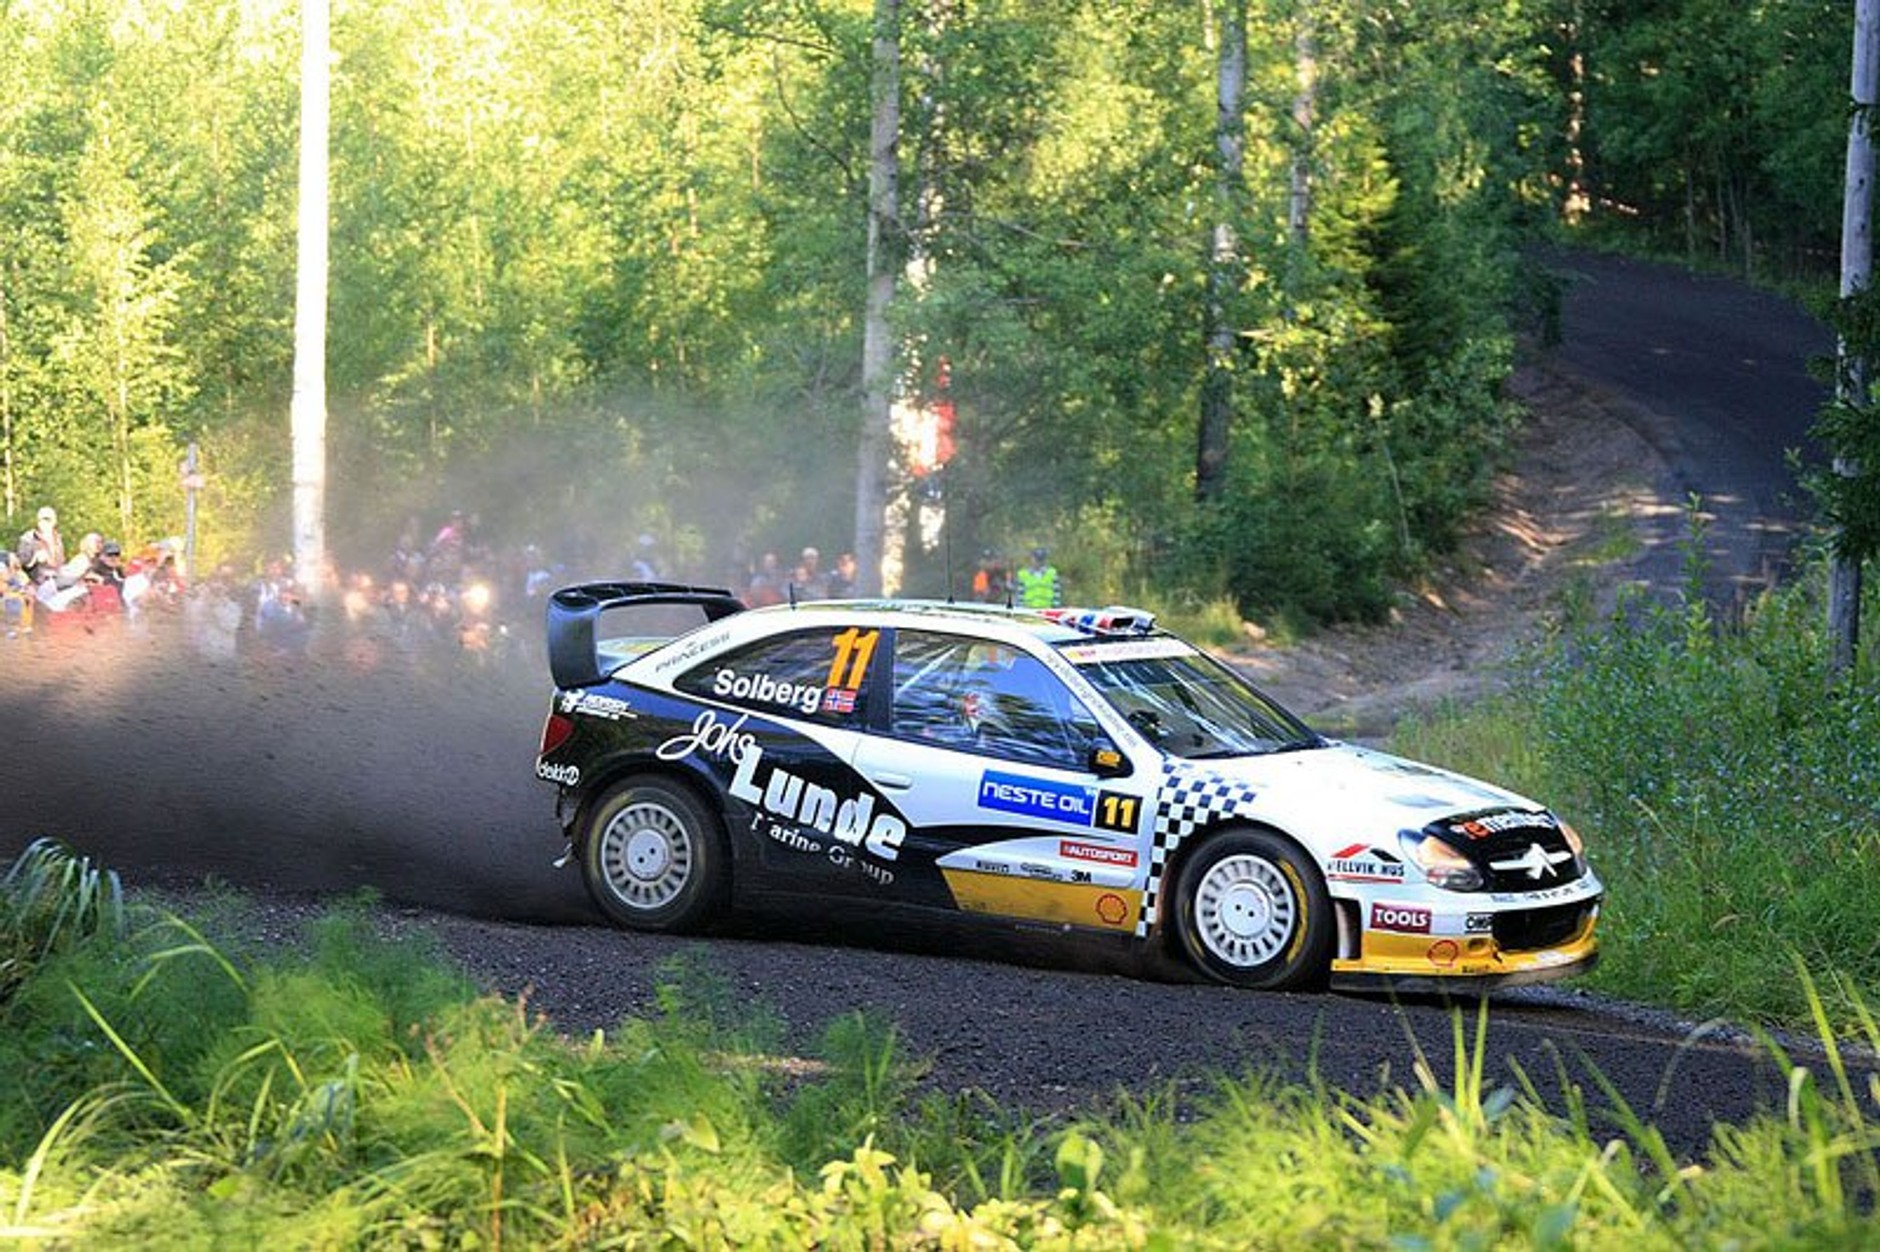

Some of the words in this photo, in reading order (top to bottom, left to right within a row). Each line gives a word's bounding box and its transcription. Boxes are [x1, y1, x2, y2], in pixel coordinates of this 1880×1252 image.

[825, 627, 880, 690] 11
[713, 669, 823, 713] Solberg
[729, 744, 907, 861] Lunde
[1058, 795, 1090, 815] OIL
[1103, 796, 1135, 828] 11
[1071, 869, 1092, 882] 3M
[1375, 908, 1428, 928] TOOLS
